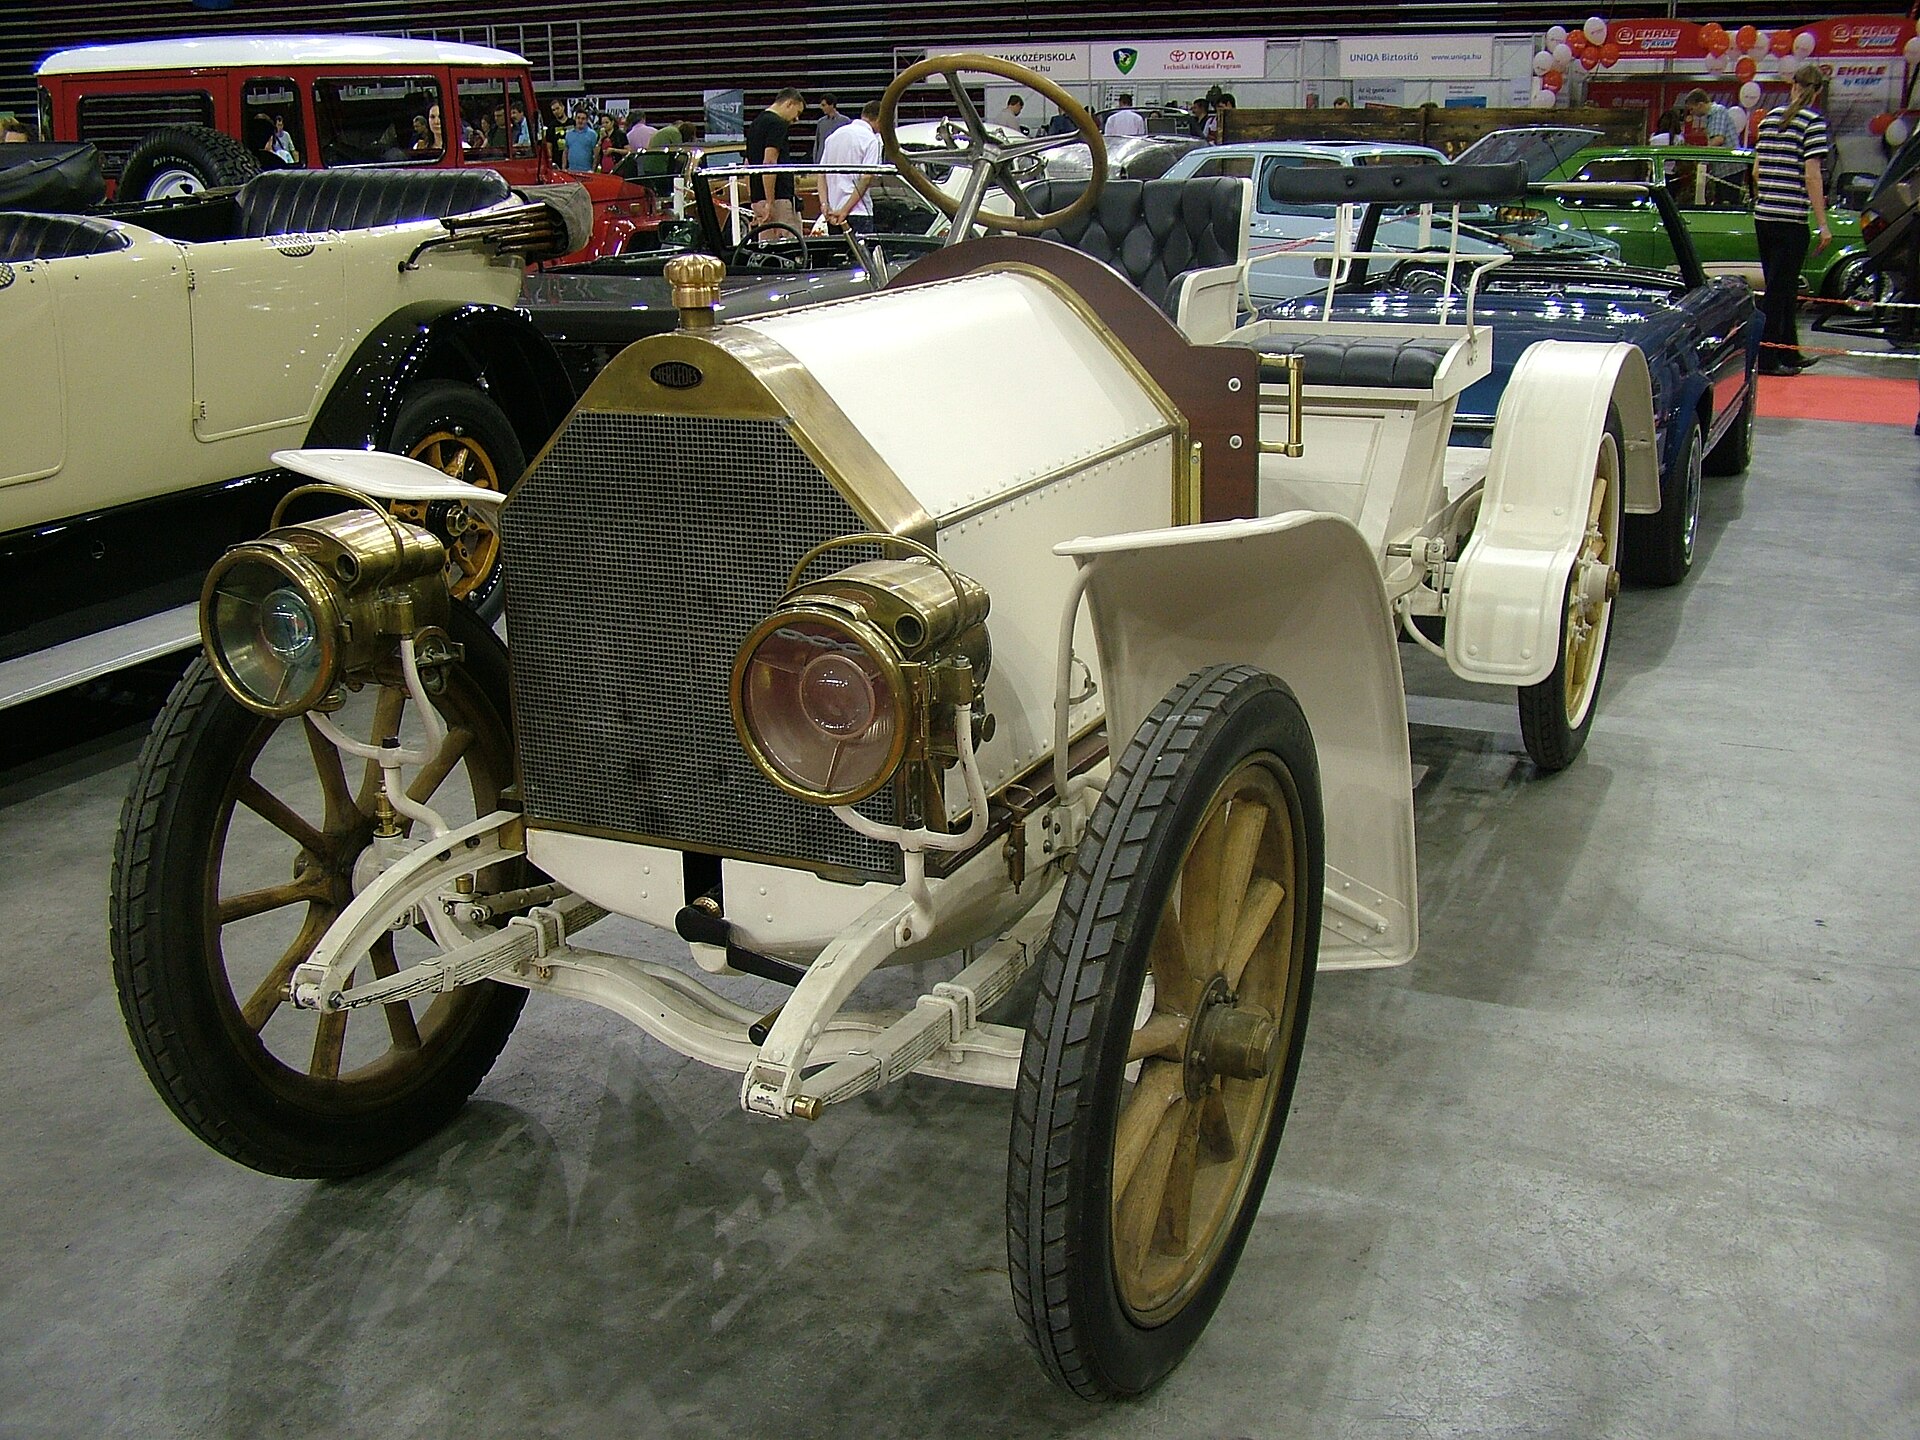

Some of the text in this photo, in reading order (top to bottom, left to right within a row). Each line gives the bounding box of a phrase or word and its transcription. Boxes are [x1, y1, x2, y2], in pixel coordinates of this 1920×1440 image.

[1635, 29, 1680, 40] EHRLE
[1188, 51, 1235, 61] TOYOTA
[1350, 52, 1482, 62] UNIQA Biztosító www.uniqa.hu
[1837, 66, 1886, 76] EHRLE
[1843, 78, 1852, 87] by
[653, 364, 698, 386] MERCEDES
